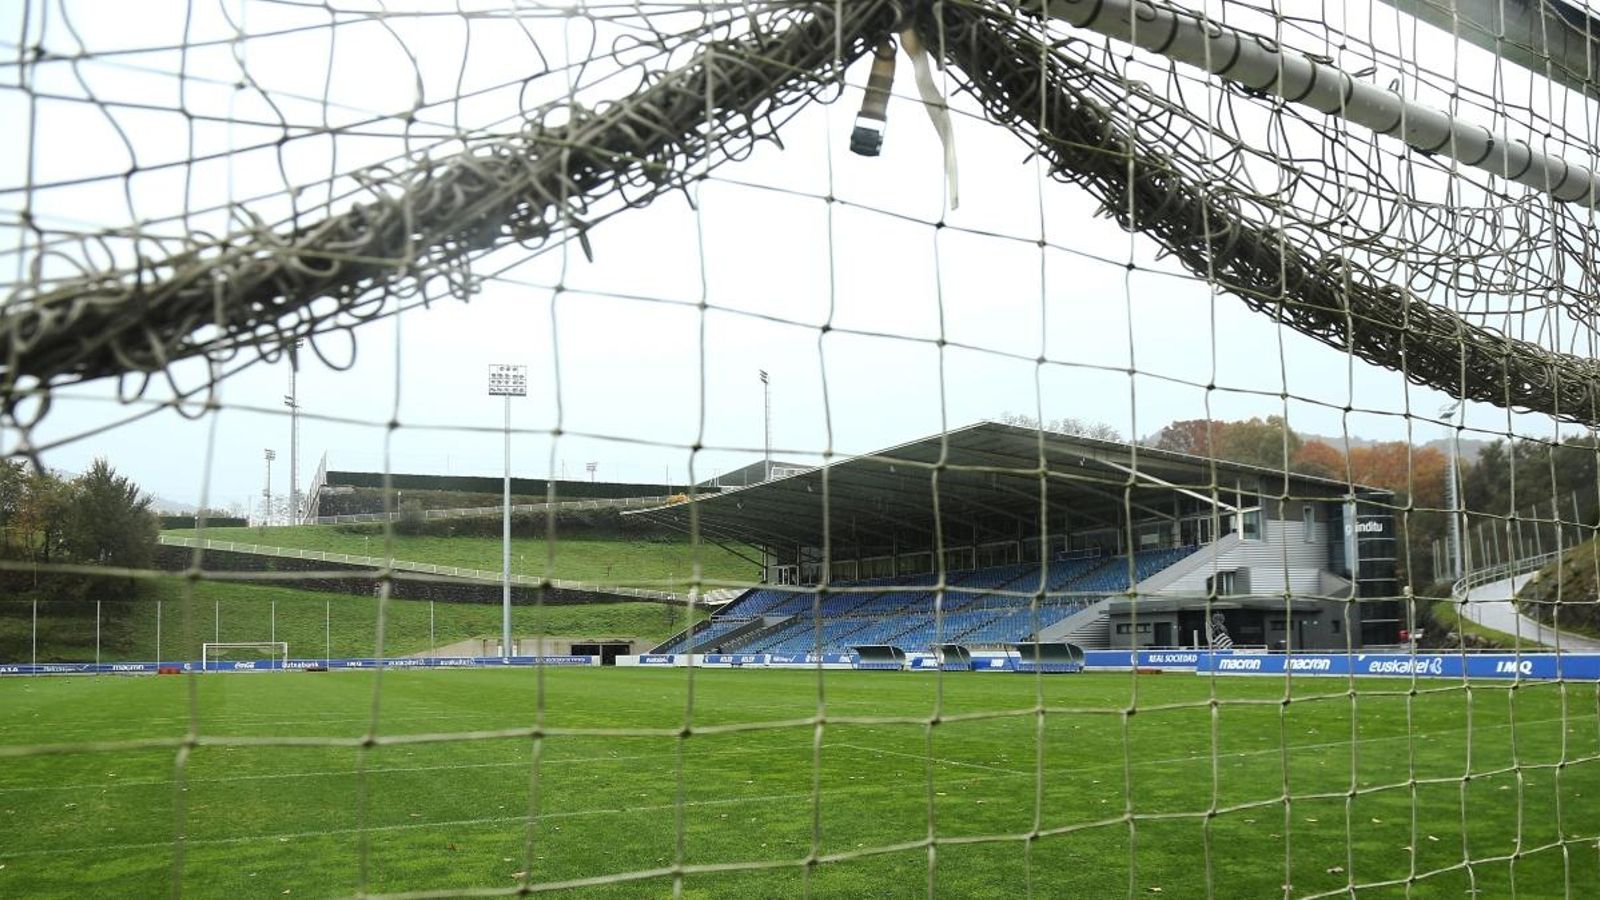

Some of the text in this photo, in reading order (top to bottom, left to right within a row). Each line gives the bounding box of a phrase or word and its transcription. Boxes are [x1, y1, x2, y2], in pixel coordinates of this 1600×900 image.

[1345, 521, 1383, 536] ginditu
[1219, 659, 1261, 669] macron
[1283, 659, 1330, 669] macron
[1368, 659, 1430, 673] euskaltel
[1496, 660, 1533, 674] IMQ
